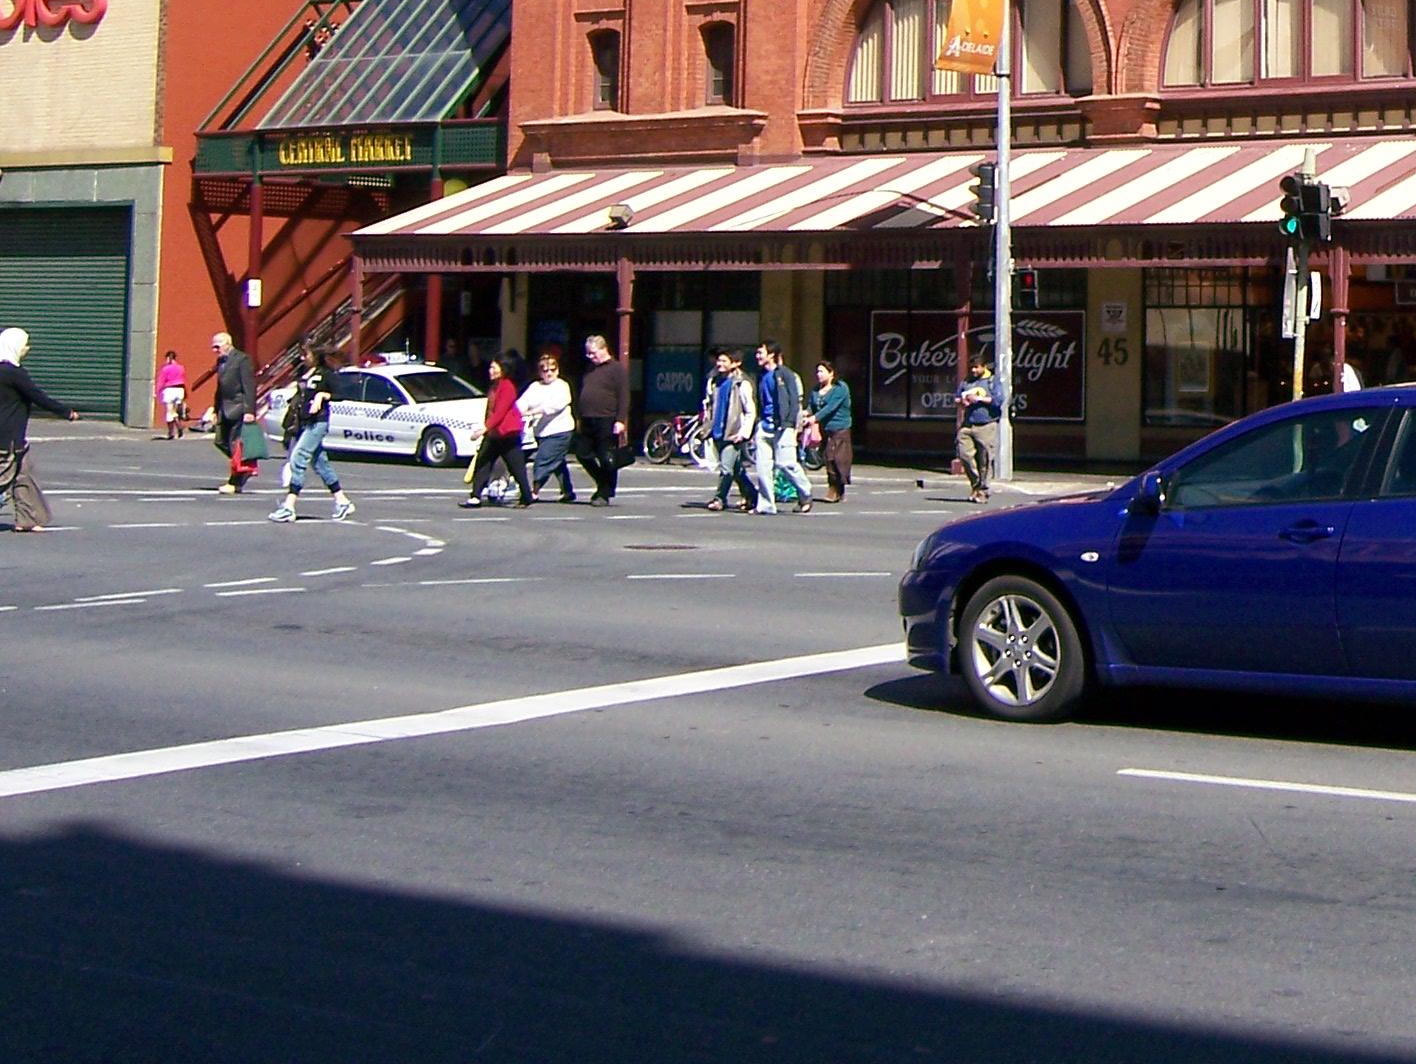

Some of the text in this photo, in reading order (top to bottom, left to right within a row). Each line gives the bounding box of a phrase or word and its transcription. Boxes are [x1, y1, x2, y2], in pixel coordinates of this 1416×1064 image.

[278, 135, 412, 165] CENTRAL MARKET
[876, 332, 959, 370] Baker
[1097, 338, 1128, 366] 45
[920, 392, 957, 409] OPE
[343, 428, 395, 443] Police
